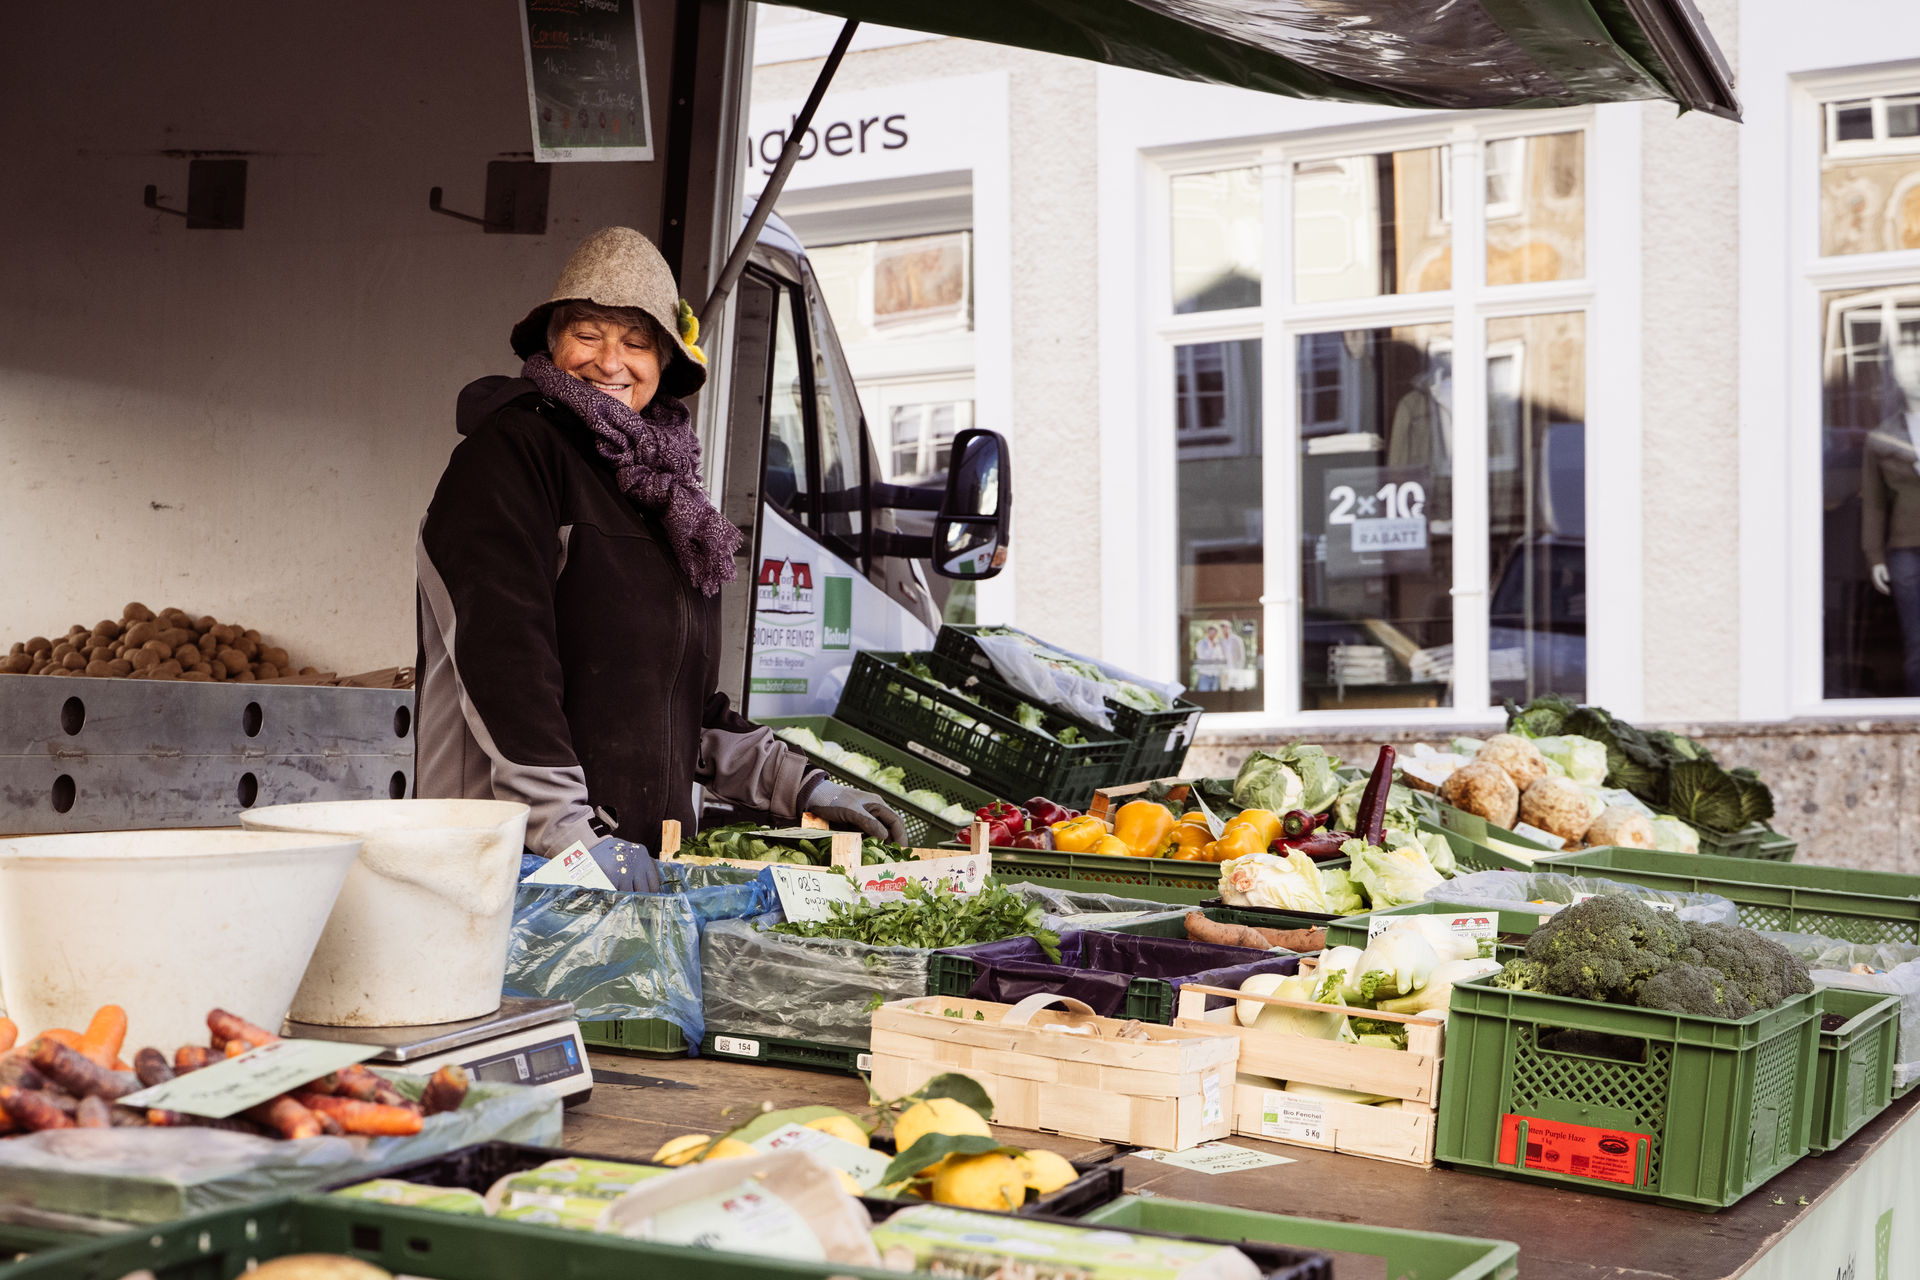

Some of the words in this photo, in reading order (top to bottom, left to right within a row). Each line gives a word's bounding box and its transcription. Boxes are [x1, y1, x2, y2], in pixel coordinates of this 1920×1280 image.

[1360, 531, 1418, 544] RABATT
[786, 629, 815, 648] REINER
[738, 1042, 751, 1051] 154
[1295, 1111, 1322, 1120] Fenchel
[1305, 1128, 1310, 1137] 5
[1311, 1129, 1320, 1139] Kg
[1514, 1124, 1544, 1136] Kotten
[1545, 1129, 1567, 1141] Purple
[1568, 1133, 1586, 1143] Haze
